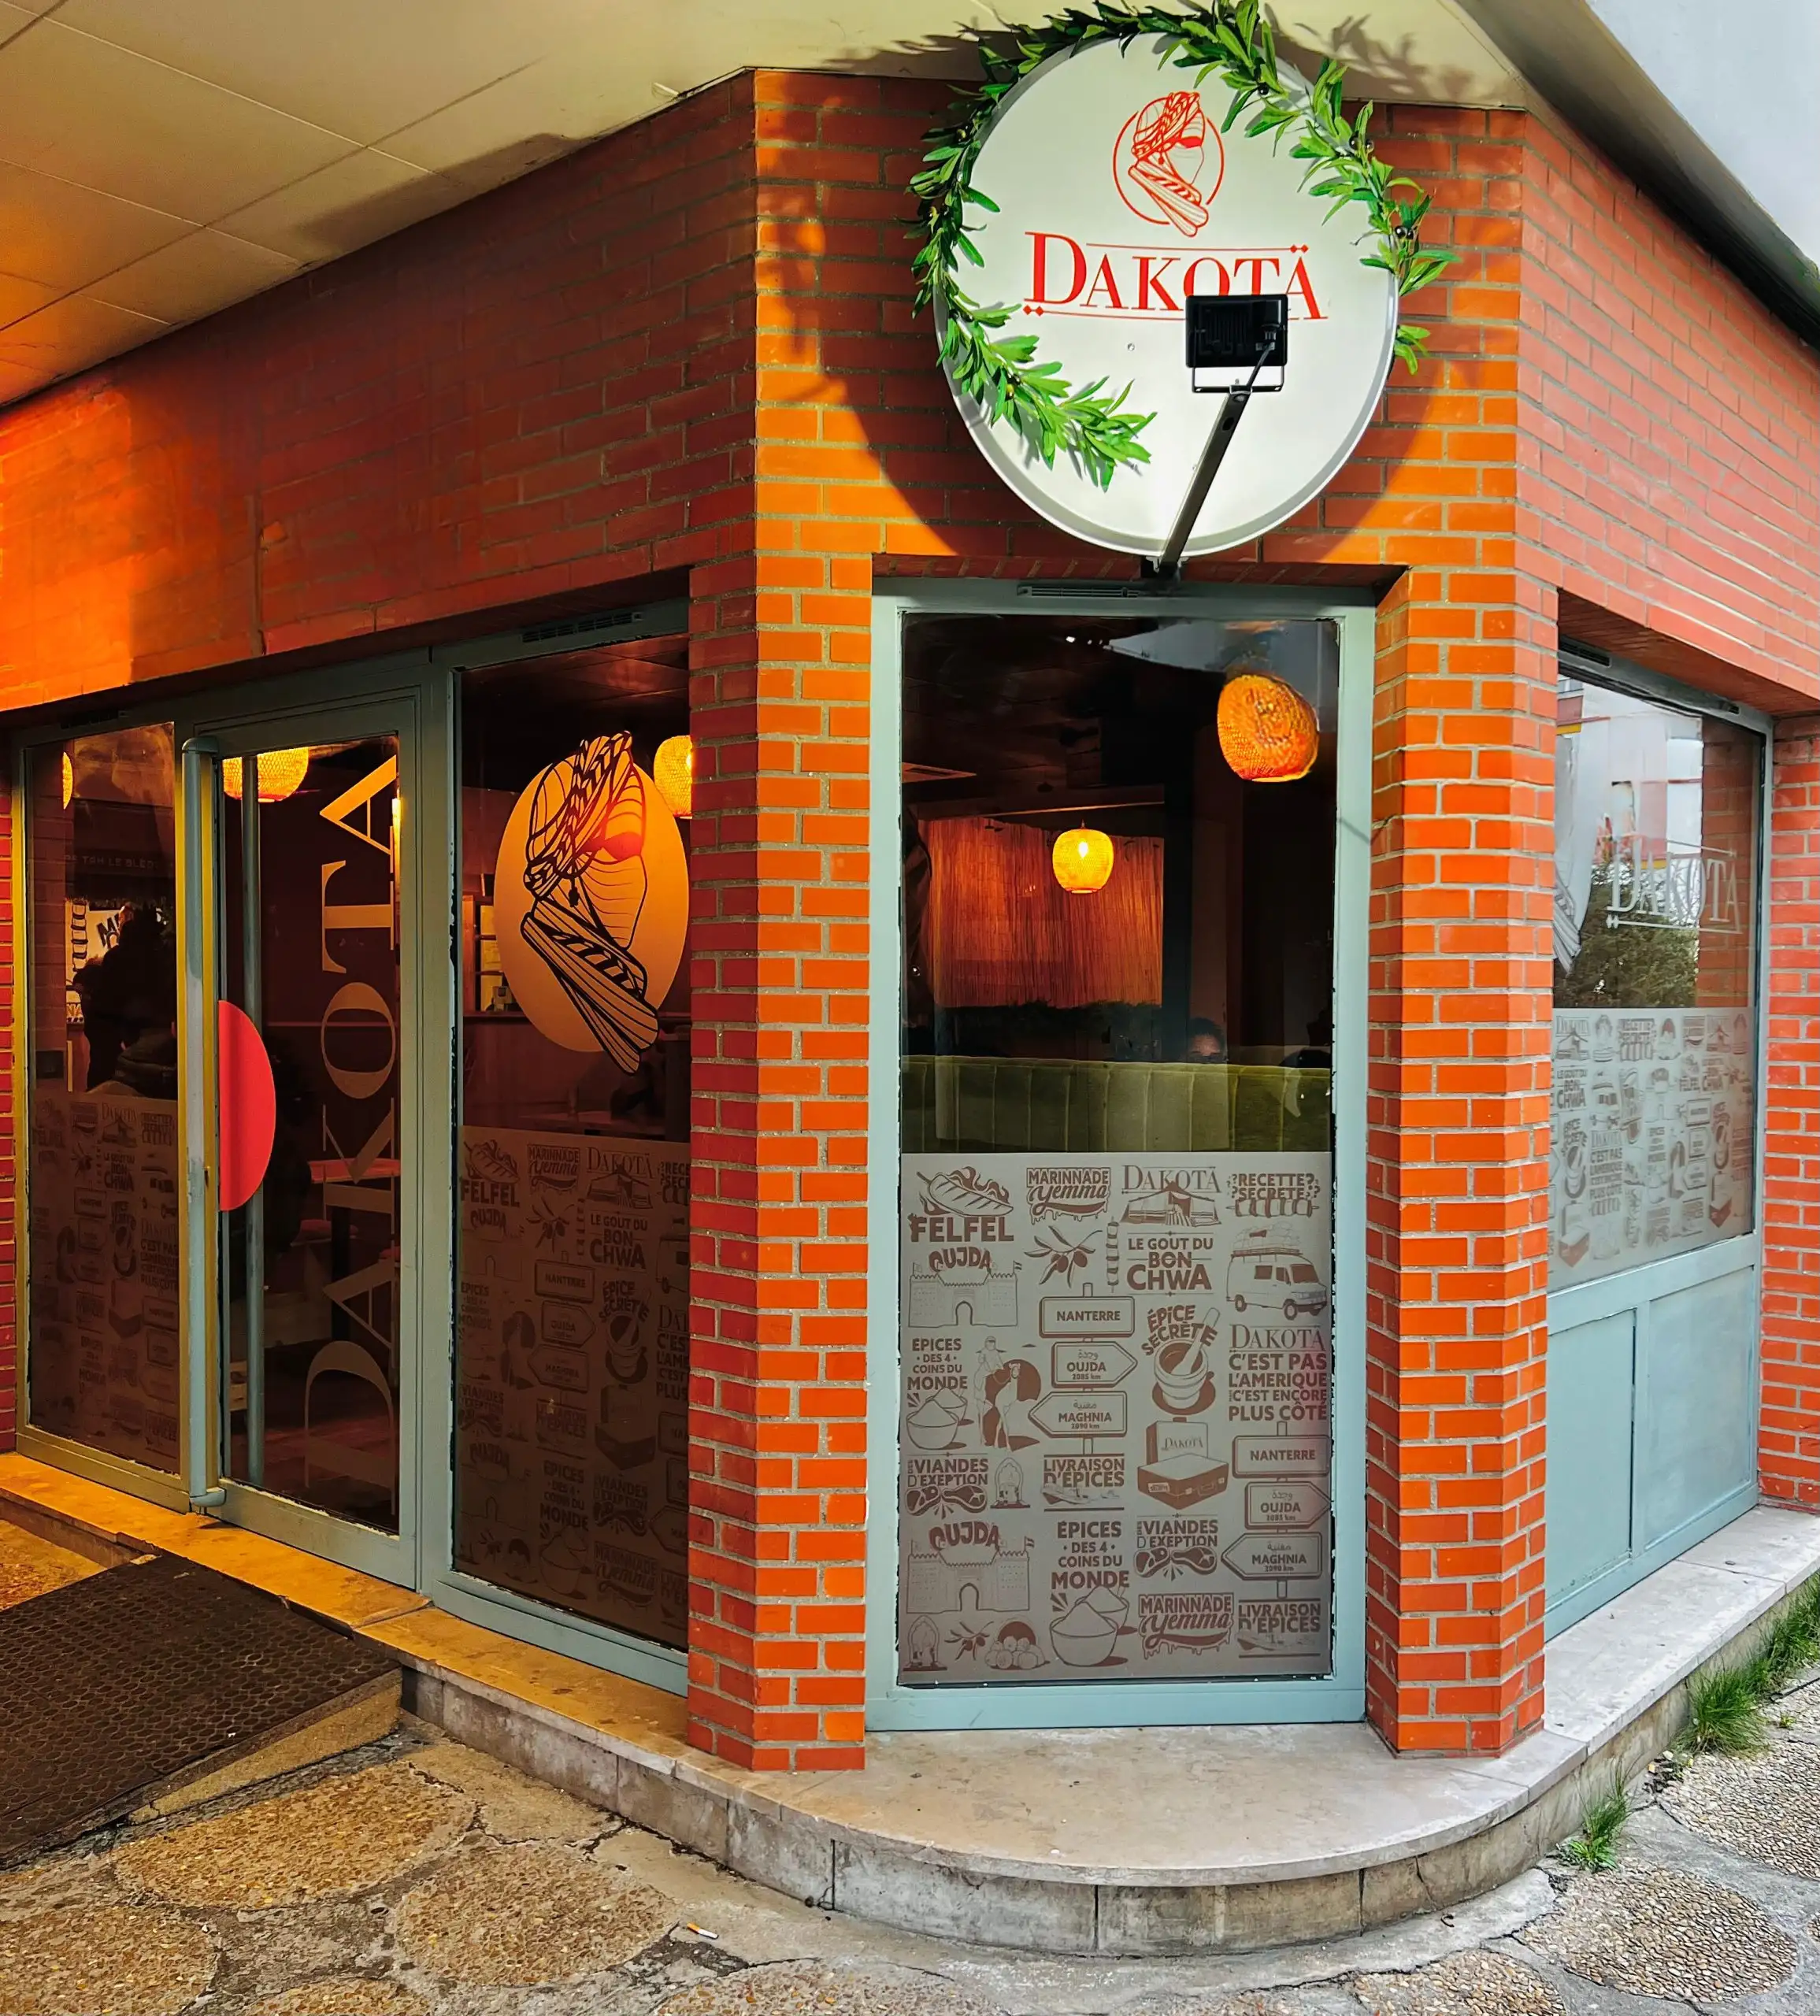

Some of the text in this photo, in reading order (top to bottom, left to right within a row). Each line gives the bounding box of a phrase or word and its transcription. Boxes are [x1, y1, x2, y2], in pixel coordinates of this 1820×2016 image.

[1024, 232, 1328, 320] DAKOTA
[303, 754, 397, 1516] DAKOTA
[1029, 1170, 1109, 1184] MARINNADE
[1122, 1165, 1221, 1193] DAKOTA
[591, 1214, 601, 1225] LE
[907, 1215, 1014, 1242] FELFEL
[1128, 1238, 1214, 1250] LE GOUT DU
[590, 1239, 647, 1269] CHWA
[929, 1246, 992, 1272] OUJDA
[1148, 1251, 1192, 1269] BON
[1126, 1264, 1212, 1290] CHWA
[1056, 1310, 1121, 1322] NANTERRE
[1229, 1324, 1325, 1351] DAKOTA
[923, 1354, 951, 1363] DES 4
[1229, 1354, 1327, 1370] C'EST PAS
[913, 1364, 962, 1374] COINS DU
[1066, 1362, 1106, 1372] OUJDA
[907, 1376, 968, 1391] MONDE
[1232, 1390, 1270, 1401] C'EST
[1058, 1412, 1112, 1423] MAGHNIA
[1229, 1406, 1274, 1421] PLUS
[1251, 1450, 1315, 1461] NANTERRE
[914, 1459, 988, 1473] VIANDES
[1043, 1458, 1125, 1471] LIVRAISON
[1260, 1503, 1301, 1513] OUJDA
[1143, 1520, 1218, 1535] VIANDES
[929, 1521, 999, 1551] OUJDA
[1072, 1541, 1108, 1553] DES 4
[1058, 1555, 1122, 1568] COINS DU
[1251, 1554, 1307, 1566] MAGHNIA
[1051, 1571, 1130, 1589] MONDE
[1140, 1595, 1232, 1614] MARINNADE
[1239, 1603, 1320, 1617] LIVRAISON
